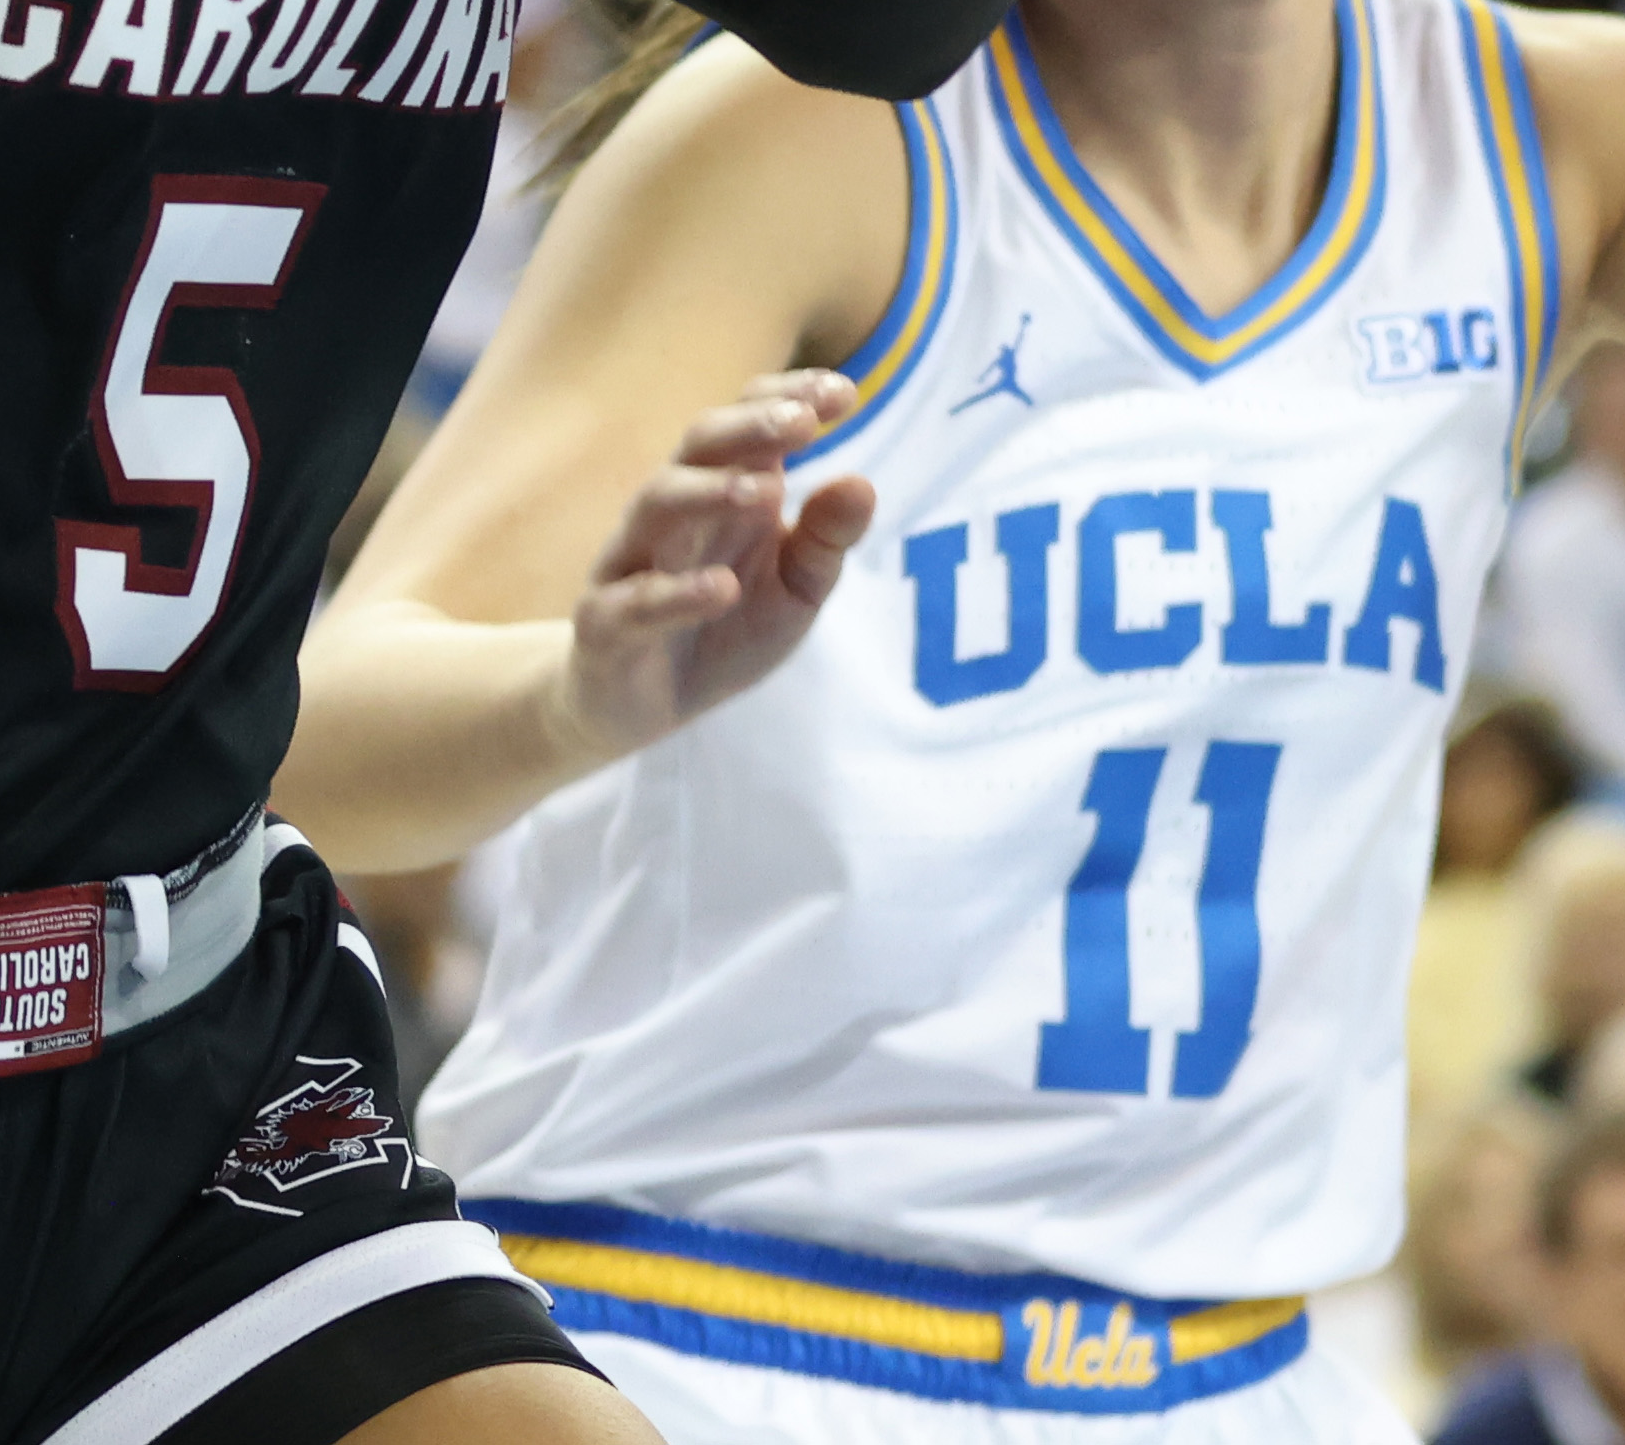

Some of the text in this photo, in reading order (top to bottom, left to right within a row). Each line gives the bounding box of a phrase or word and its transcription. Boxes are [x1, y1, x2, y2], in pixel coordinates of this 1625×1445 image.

[55, 173, 329, 691] 5
[902, 487, 1446, 710] UCLA
[1036, 740, 1284, 1100] 11
